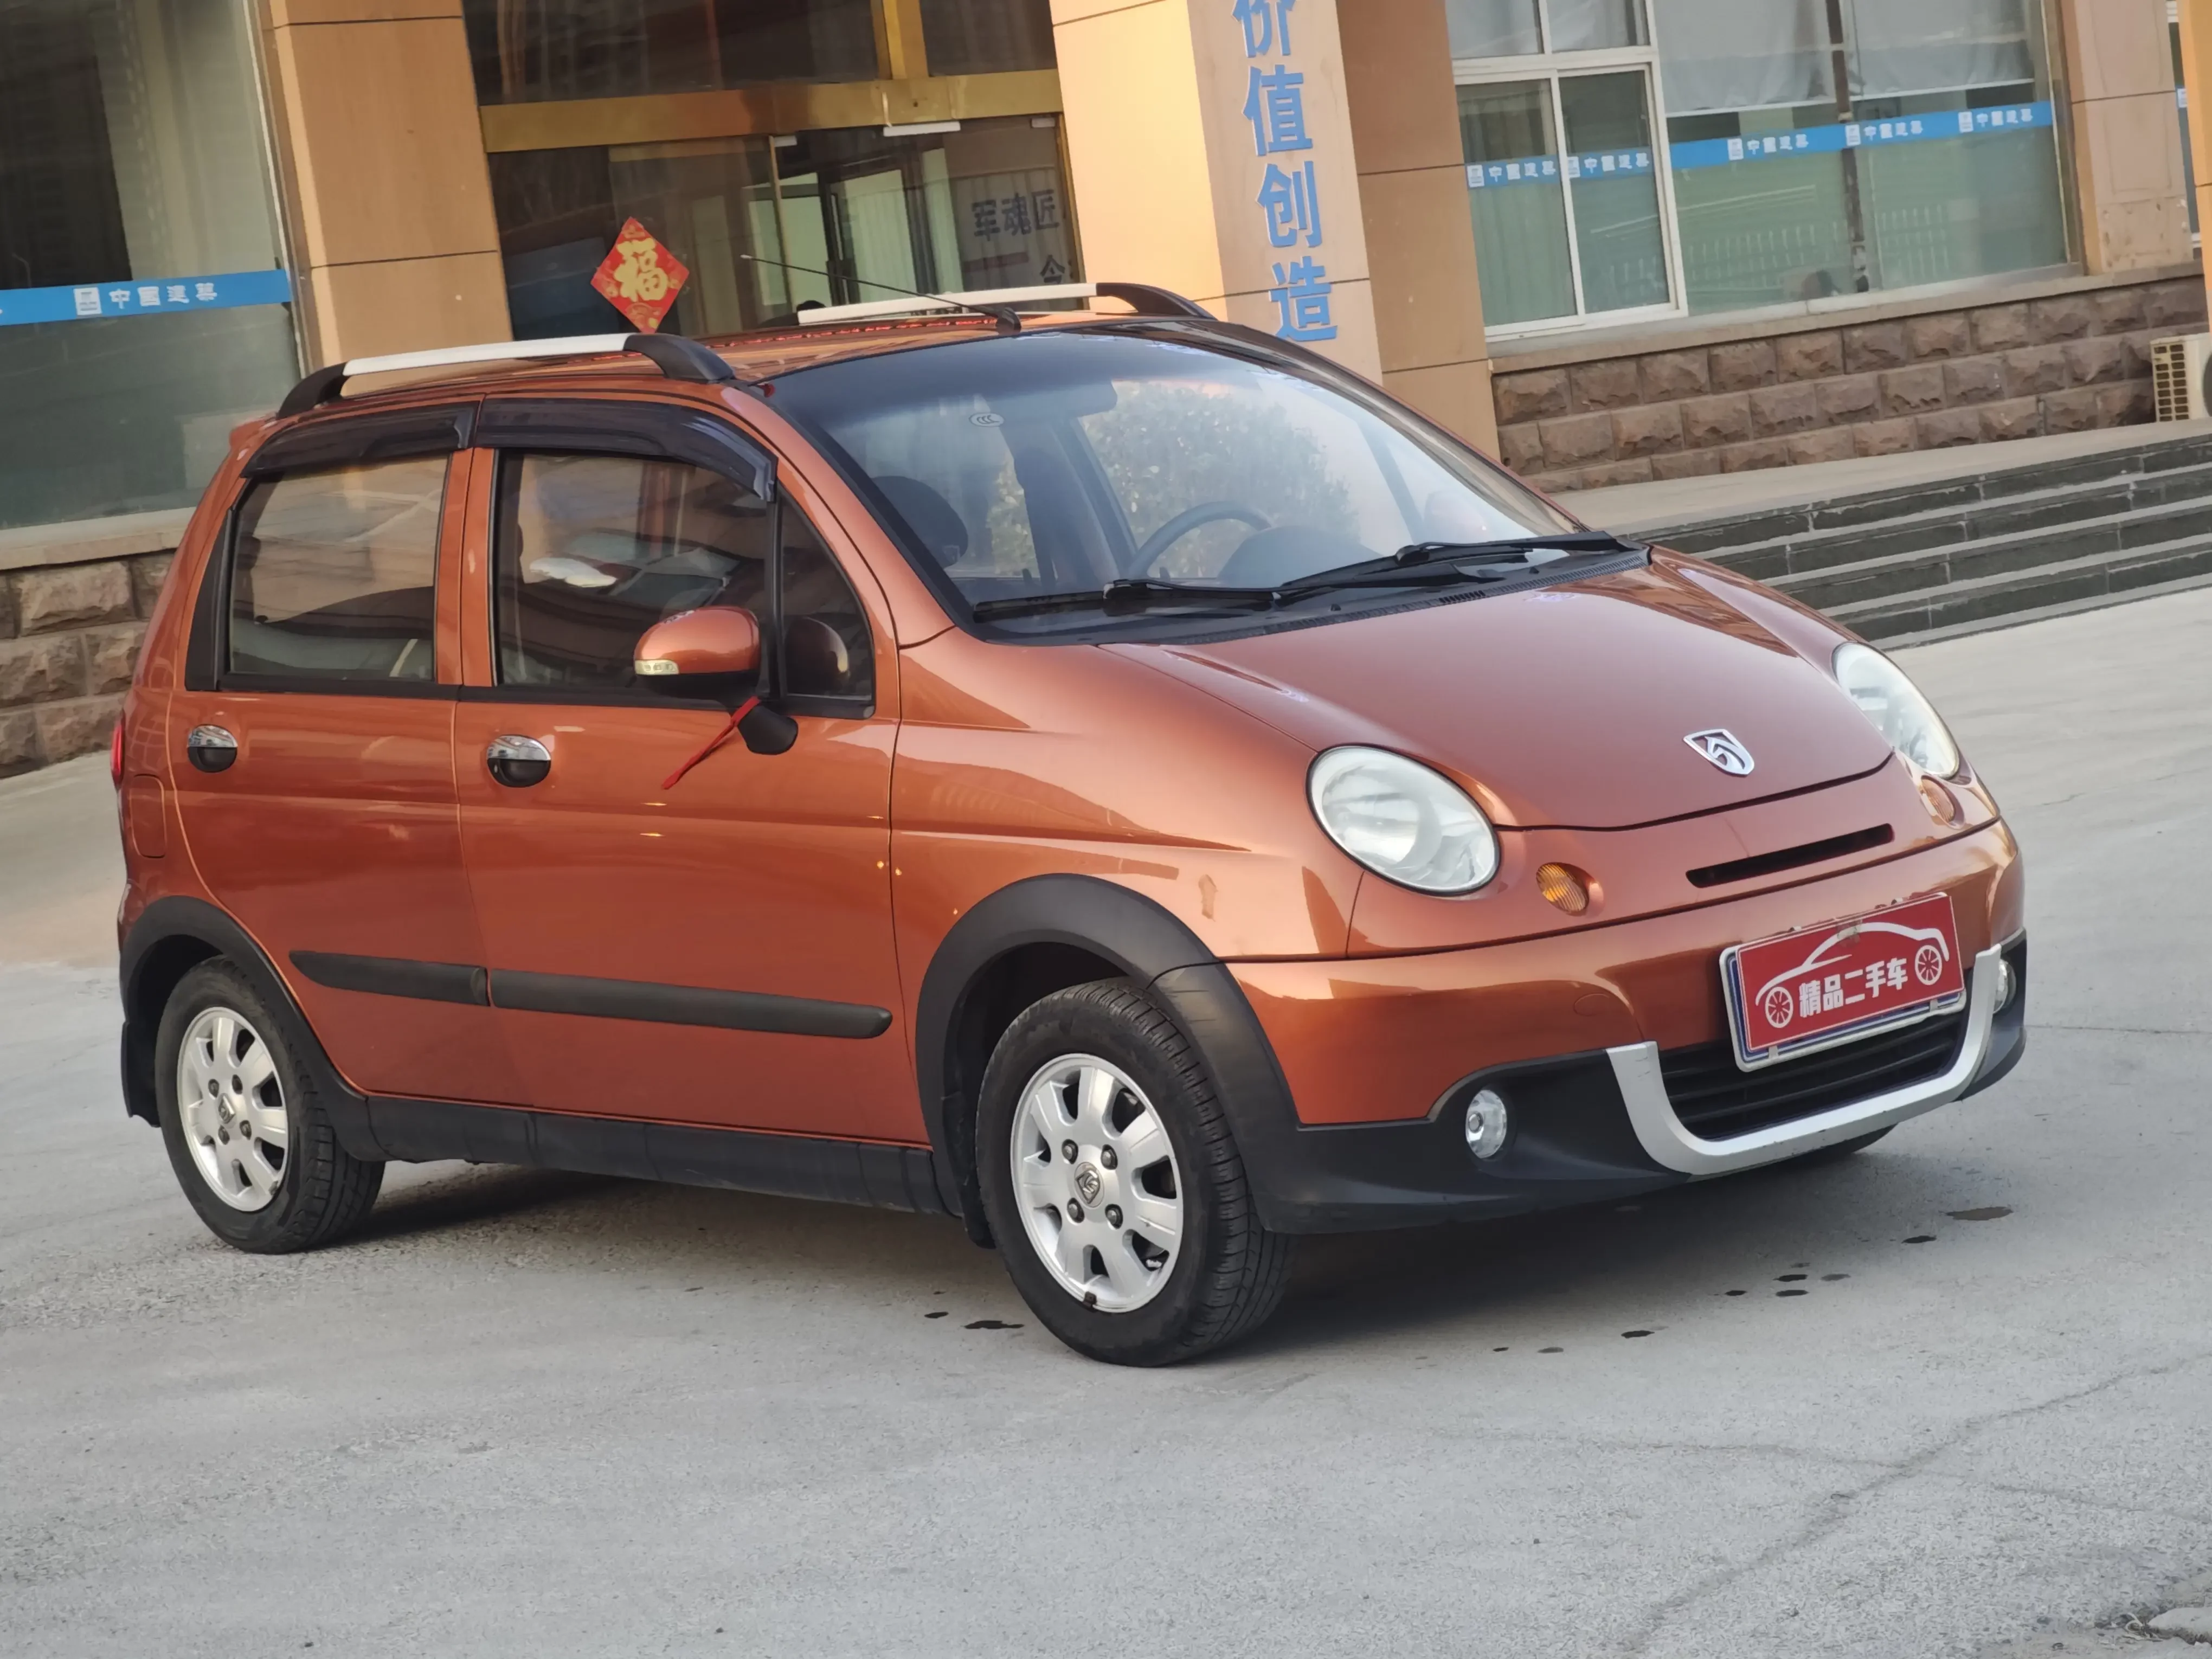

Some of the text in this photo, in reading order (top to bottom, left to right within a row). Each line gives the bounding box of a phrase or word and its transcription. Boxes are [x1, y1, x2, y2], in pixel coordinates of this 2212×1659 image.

[1231, 0, 1338, 342] 价值创造
[614, 237, 668, 302] 福
[1799, 957, 1908, 1018] 精品二手车
